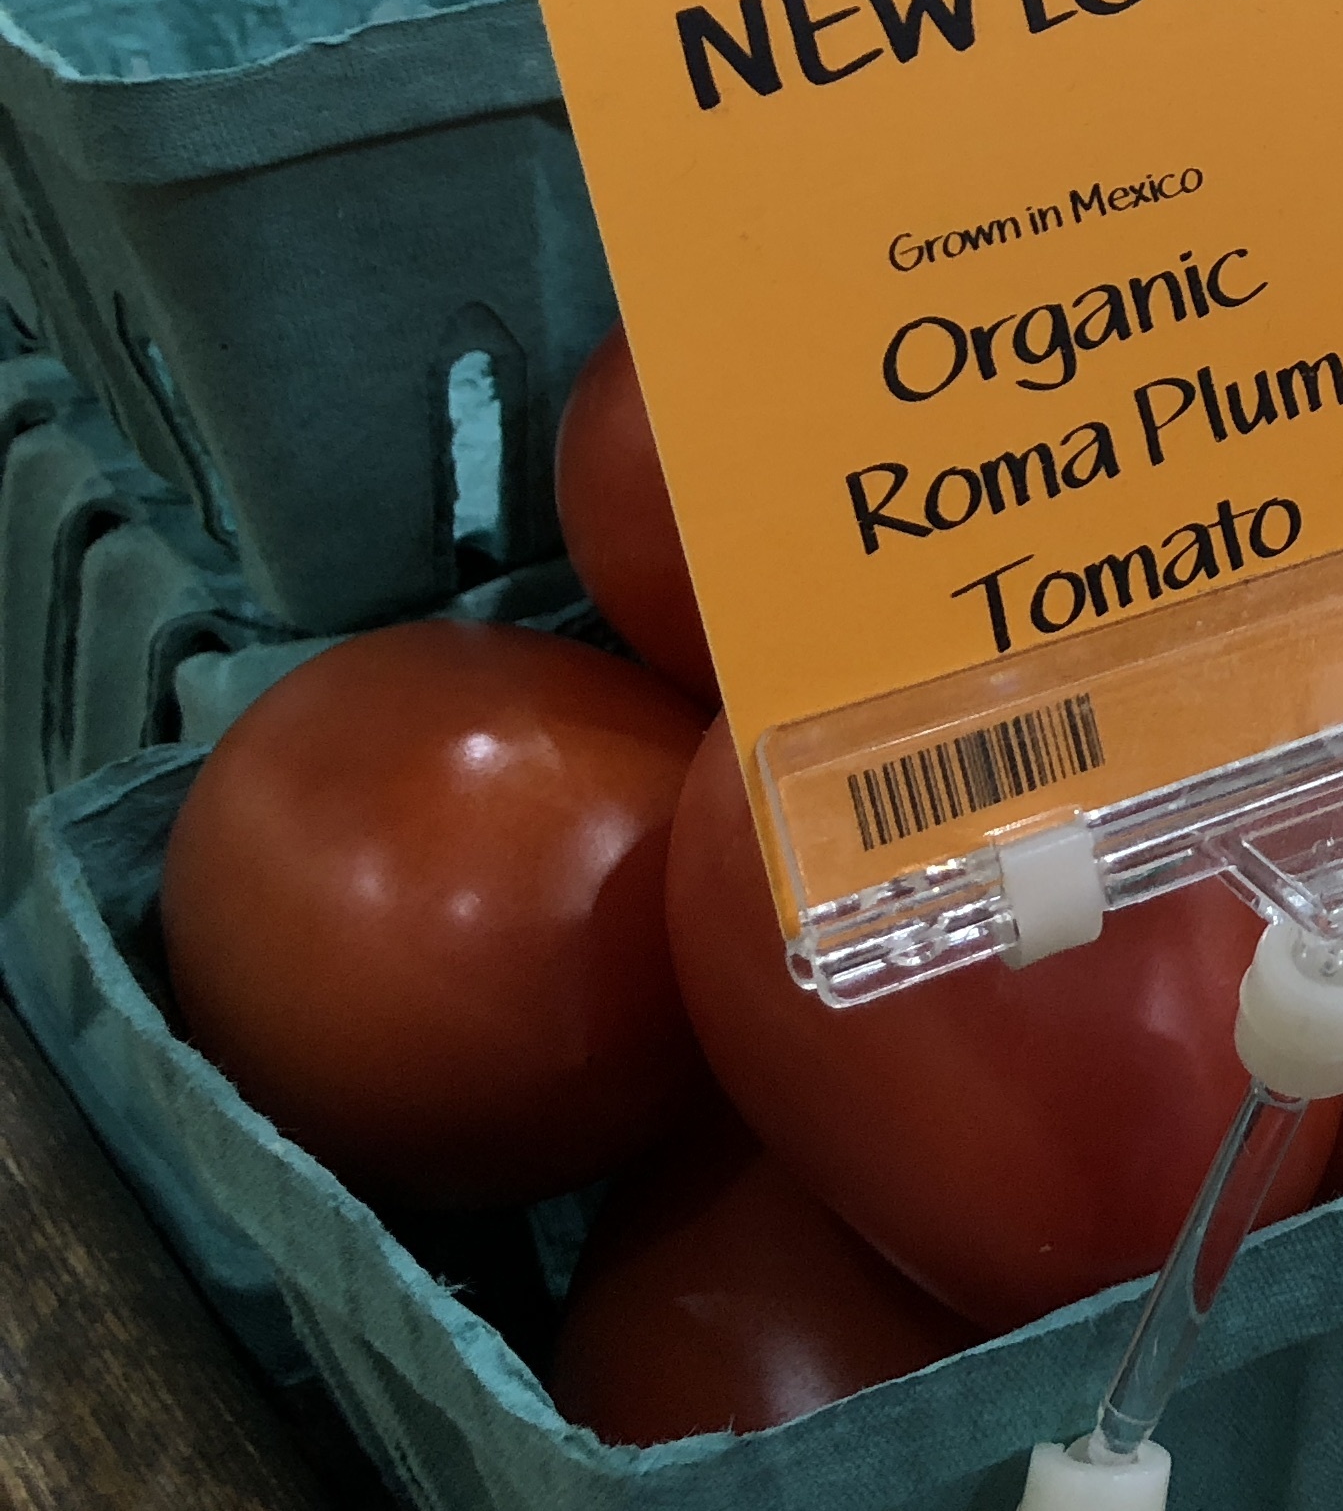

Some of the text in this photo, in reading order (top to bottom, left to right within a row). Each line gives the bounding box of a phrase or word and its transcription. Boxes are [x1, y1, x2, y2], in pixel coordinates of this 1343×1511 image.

[888, 167, 1204, 273] Grown in Mexico
[882, 248, 1269, 403] Organic
[845, 421, 1122, 556] Roma
[952, 493, 1304, 655] Tomato
